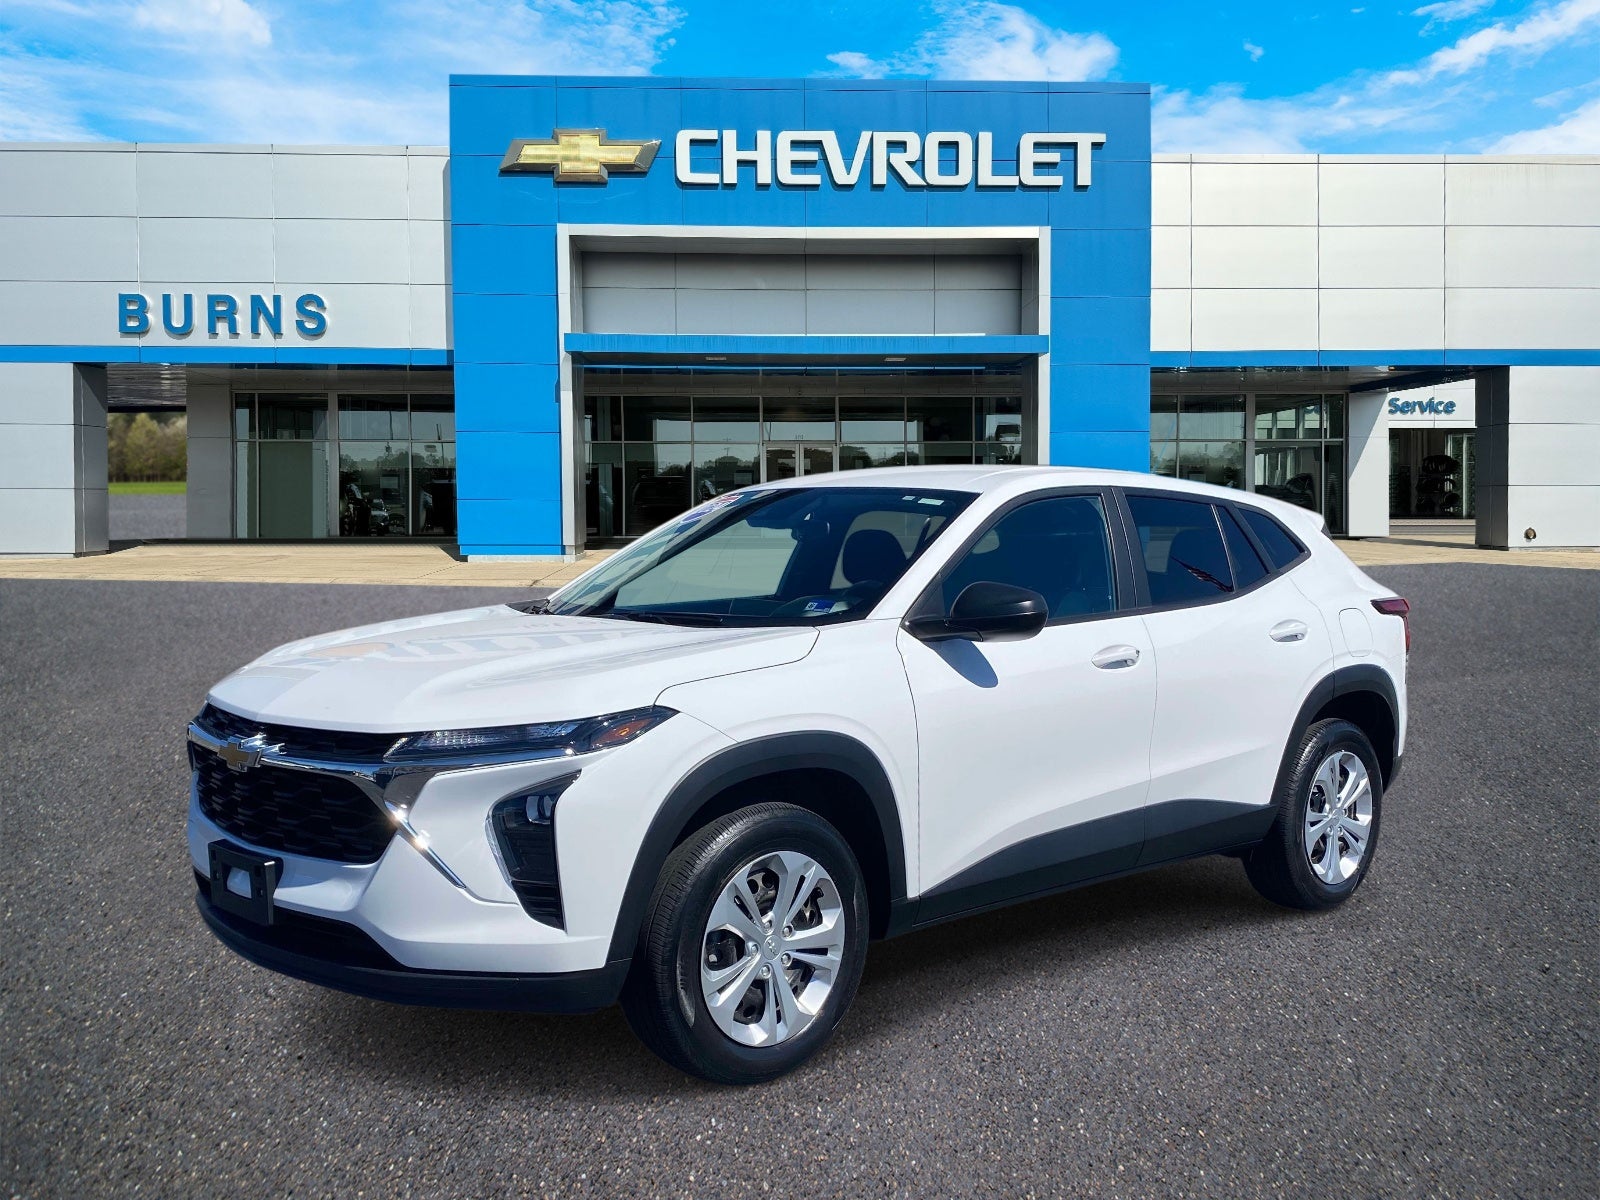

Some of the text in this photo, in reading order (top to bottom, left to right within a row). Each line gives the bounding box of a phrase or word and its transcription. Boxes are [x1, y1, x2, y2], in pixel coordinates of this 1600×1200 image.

[675, 129, 1107, 188] CHEVROLET
[118, 293, 328, 336] BURNS
[1388, 397, 1456, 415] Service
